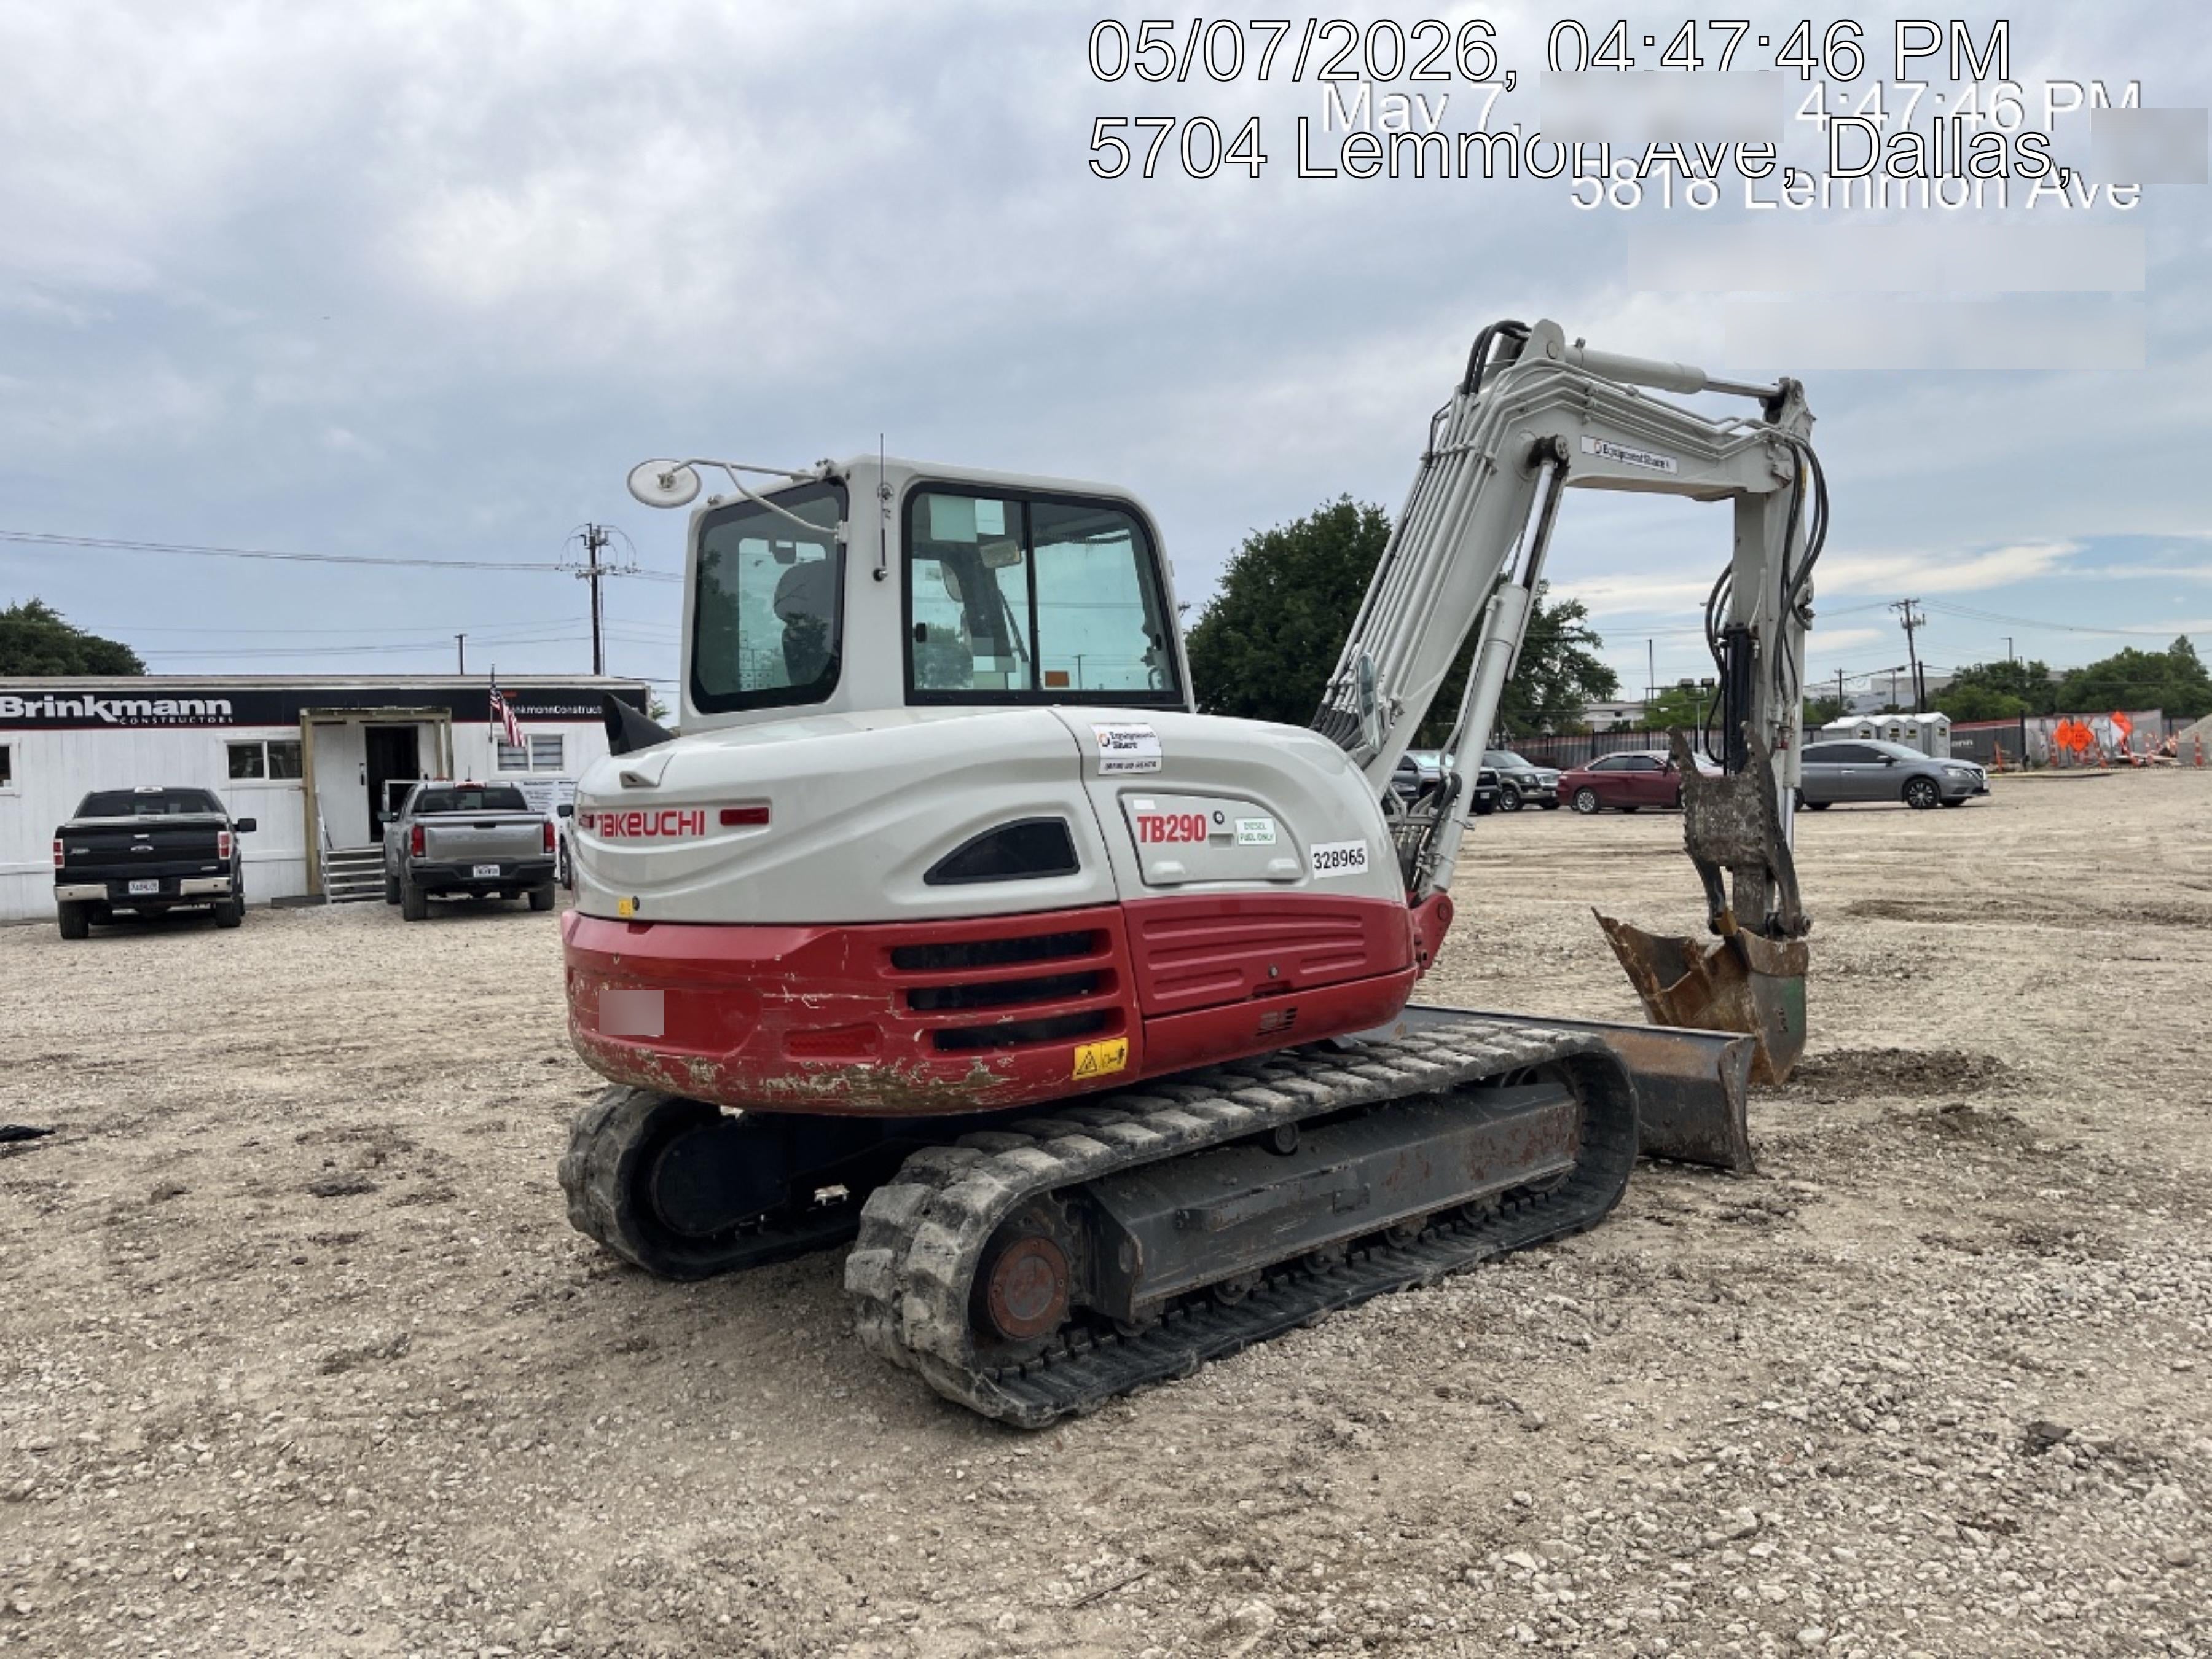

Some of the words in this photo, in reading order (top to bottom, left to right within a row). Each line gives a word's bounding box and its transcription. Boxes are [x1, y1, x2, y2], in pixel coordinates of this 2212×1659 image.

[0, 694, 233, 723] Brinkmann
[119, 716, 233, 725] CONSTRUCTORS
[1137, 814, 1206, 843] TB290
[1313, 847, 1365, 870] 328965
